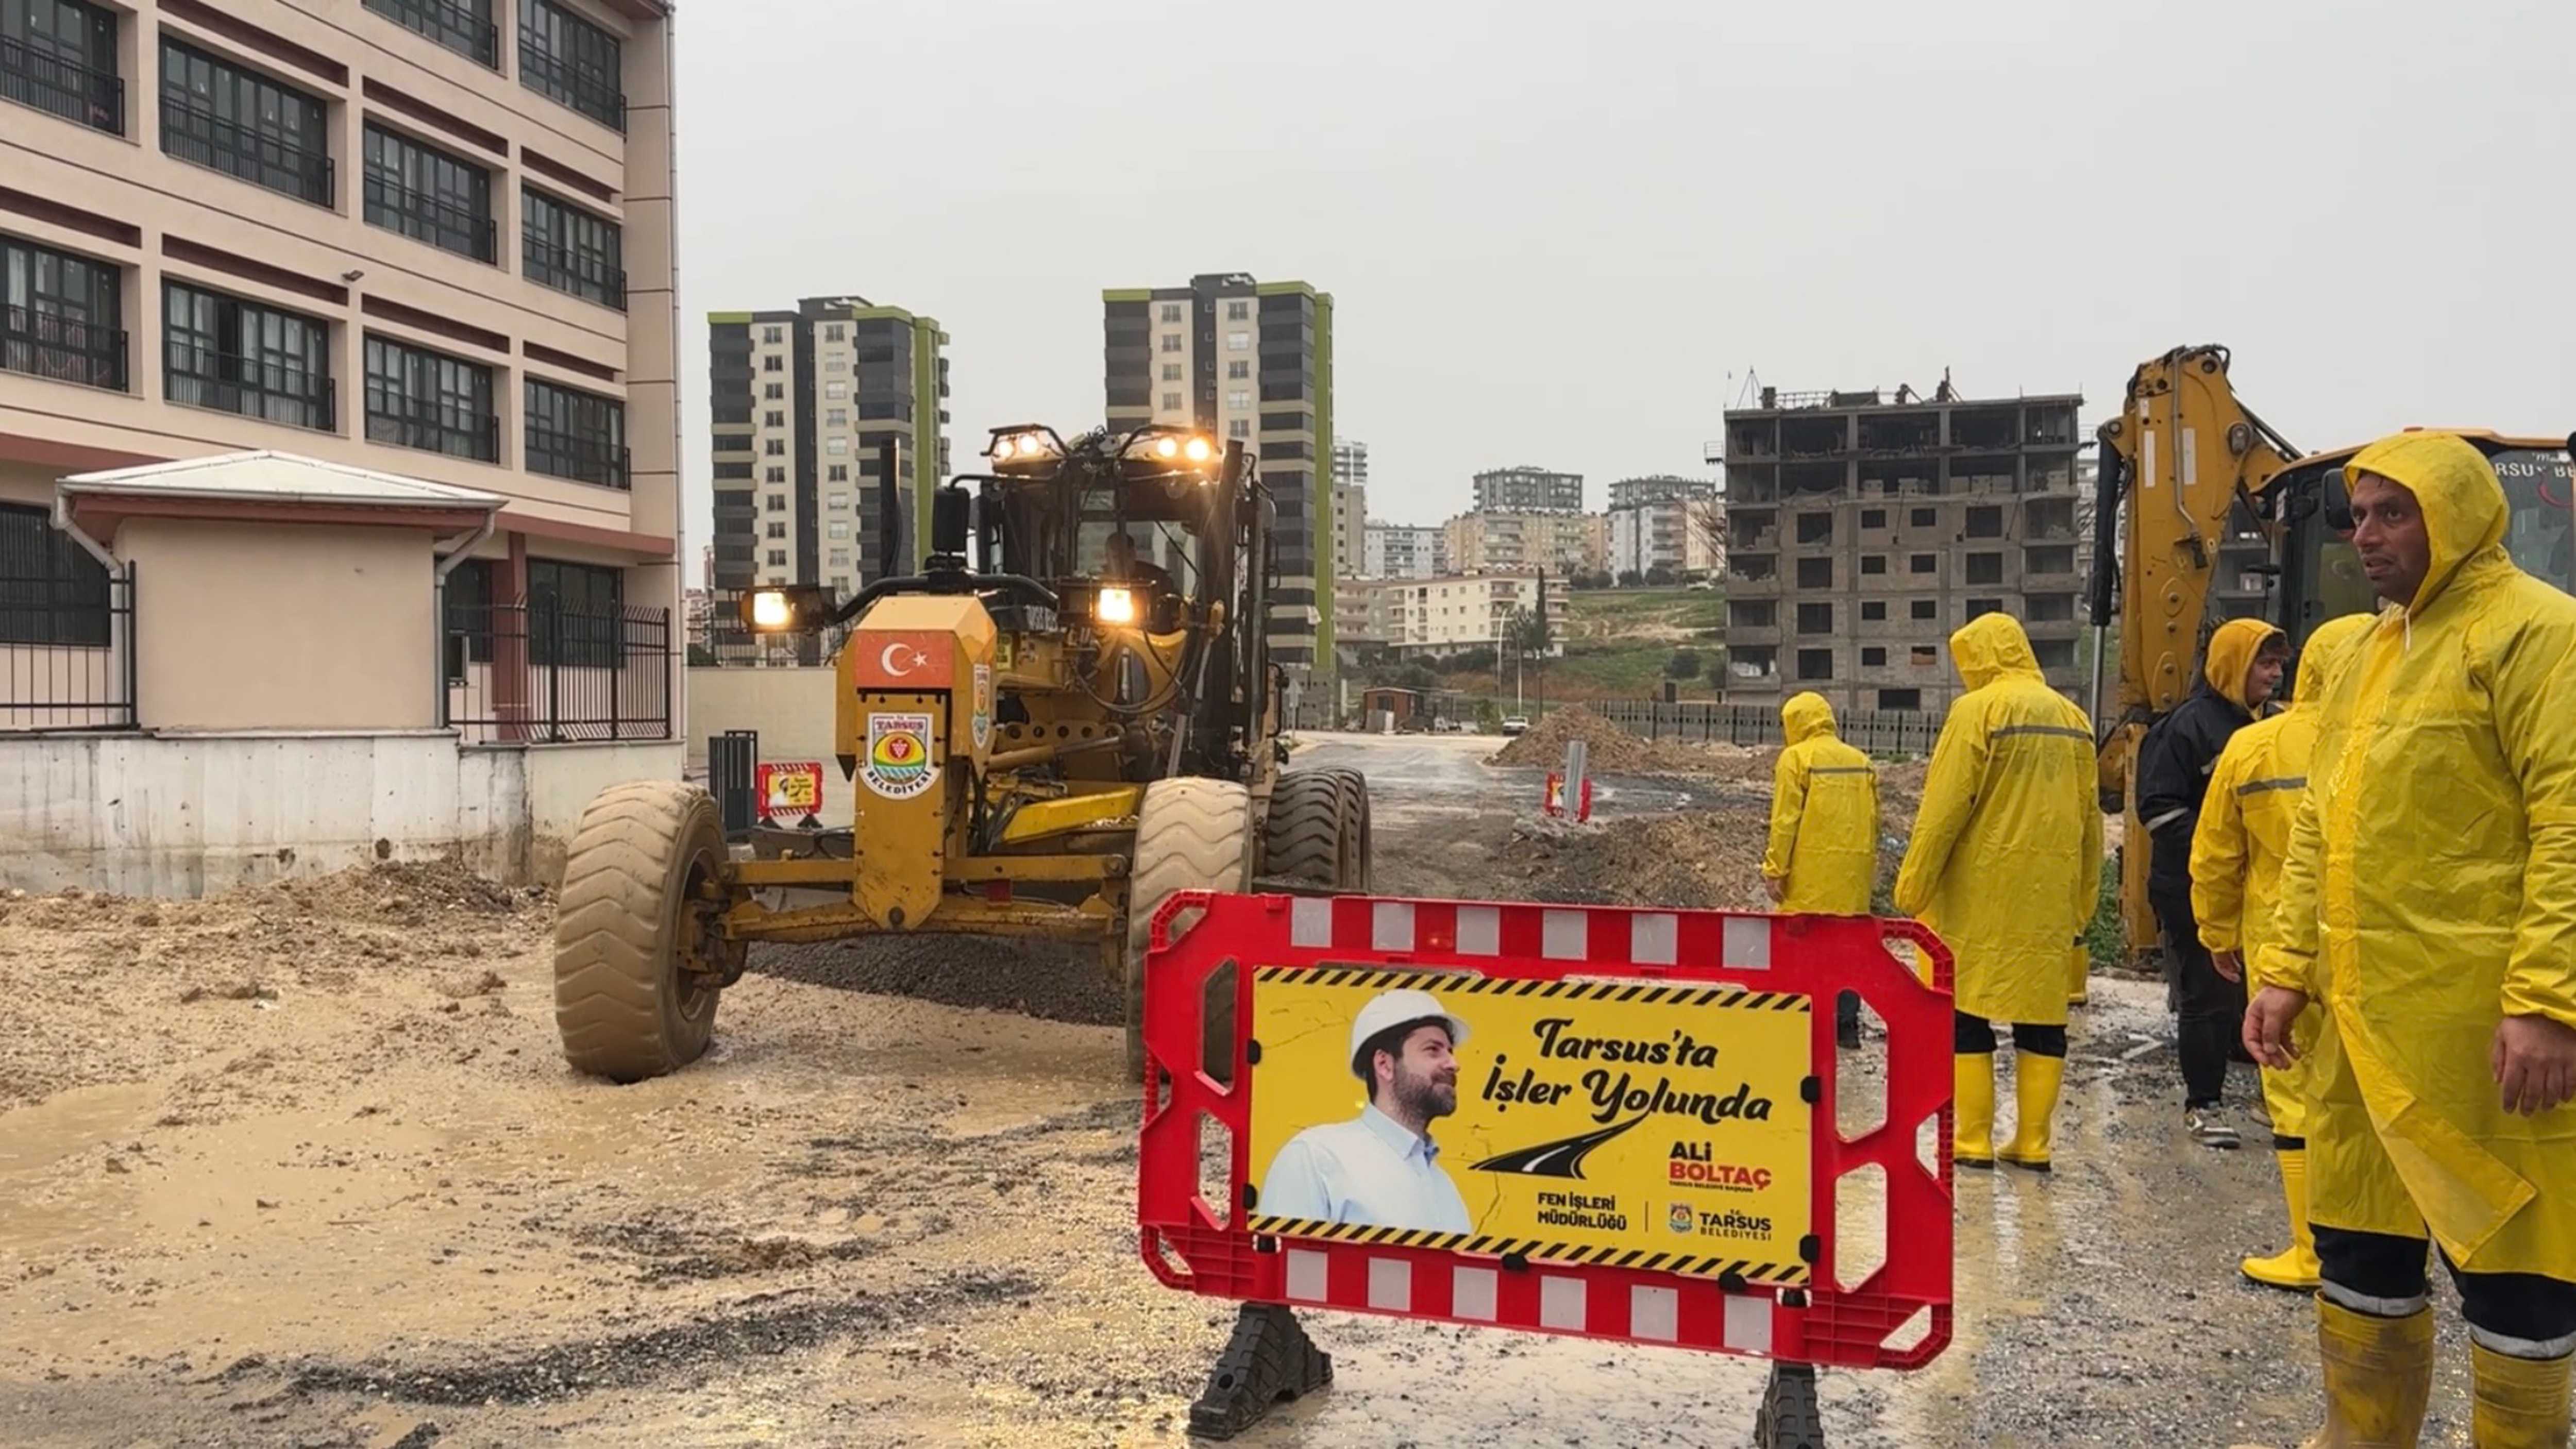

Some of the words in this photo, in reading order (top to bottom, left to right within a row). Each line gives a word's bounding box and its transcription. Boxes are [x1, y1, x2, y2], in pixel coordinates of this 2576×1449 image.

[1534, 1018, 1719, 1068] Tarsus'ta
[1482, 1054, 1572, 1113] İşler
[1581, 1069, 1772, 1125] Yolunda
[1670, 1161, 1772, 1190] BOLTAÇ
[1538, 1192, 1566, 1206] FEN
[1569, 1191, 1615, 1210] İŞLERİ
[1538, 1208, 1627, 1231] MÜDÜRLÜĞÜ
[1699, 1212, 1772, 1231] TARSUS
